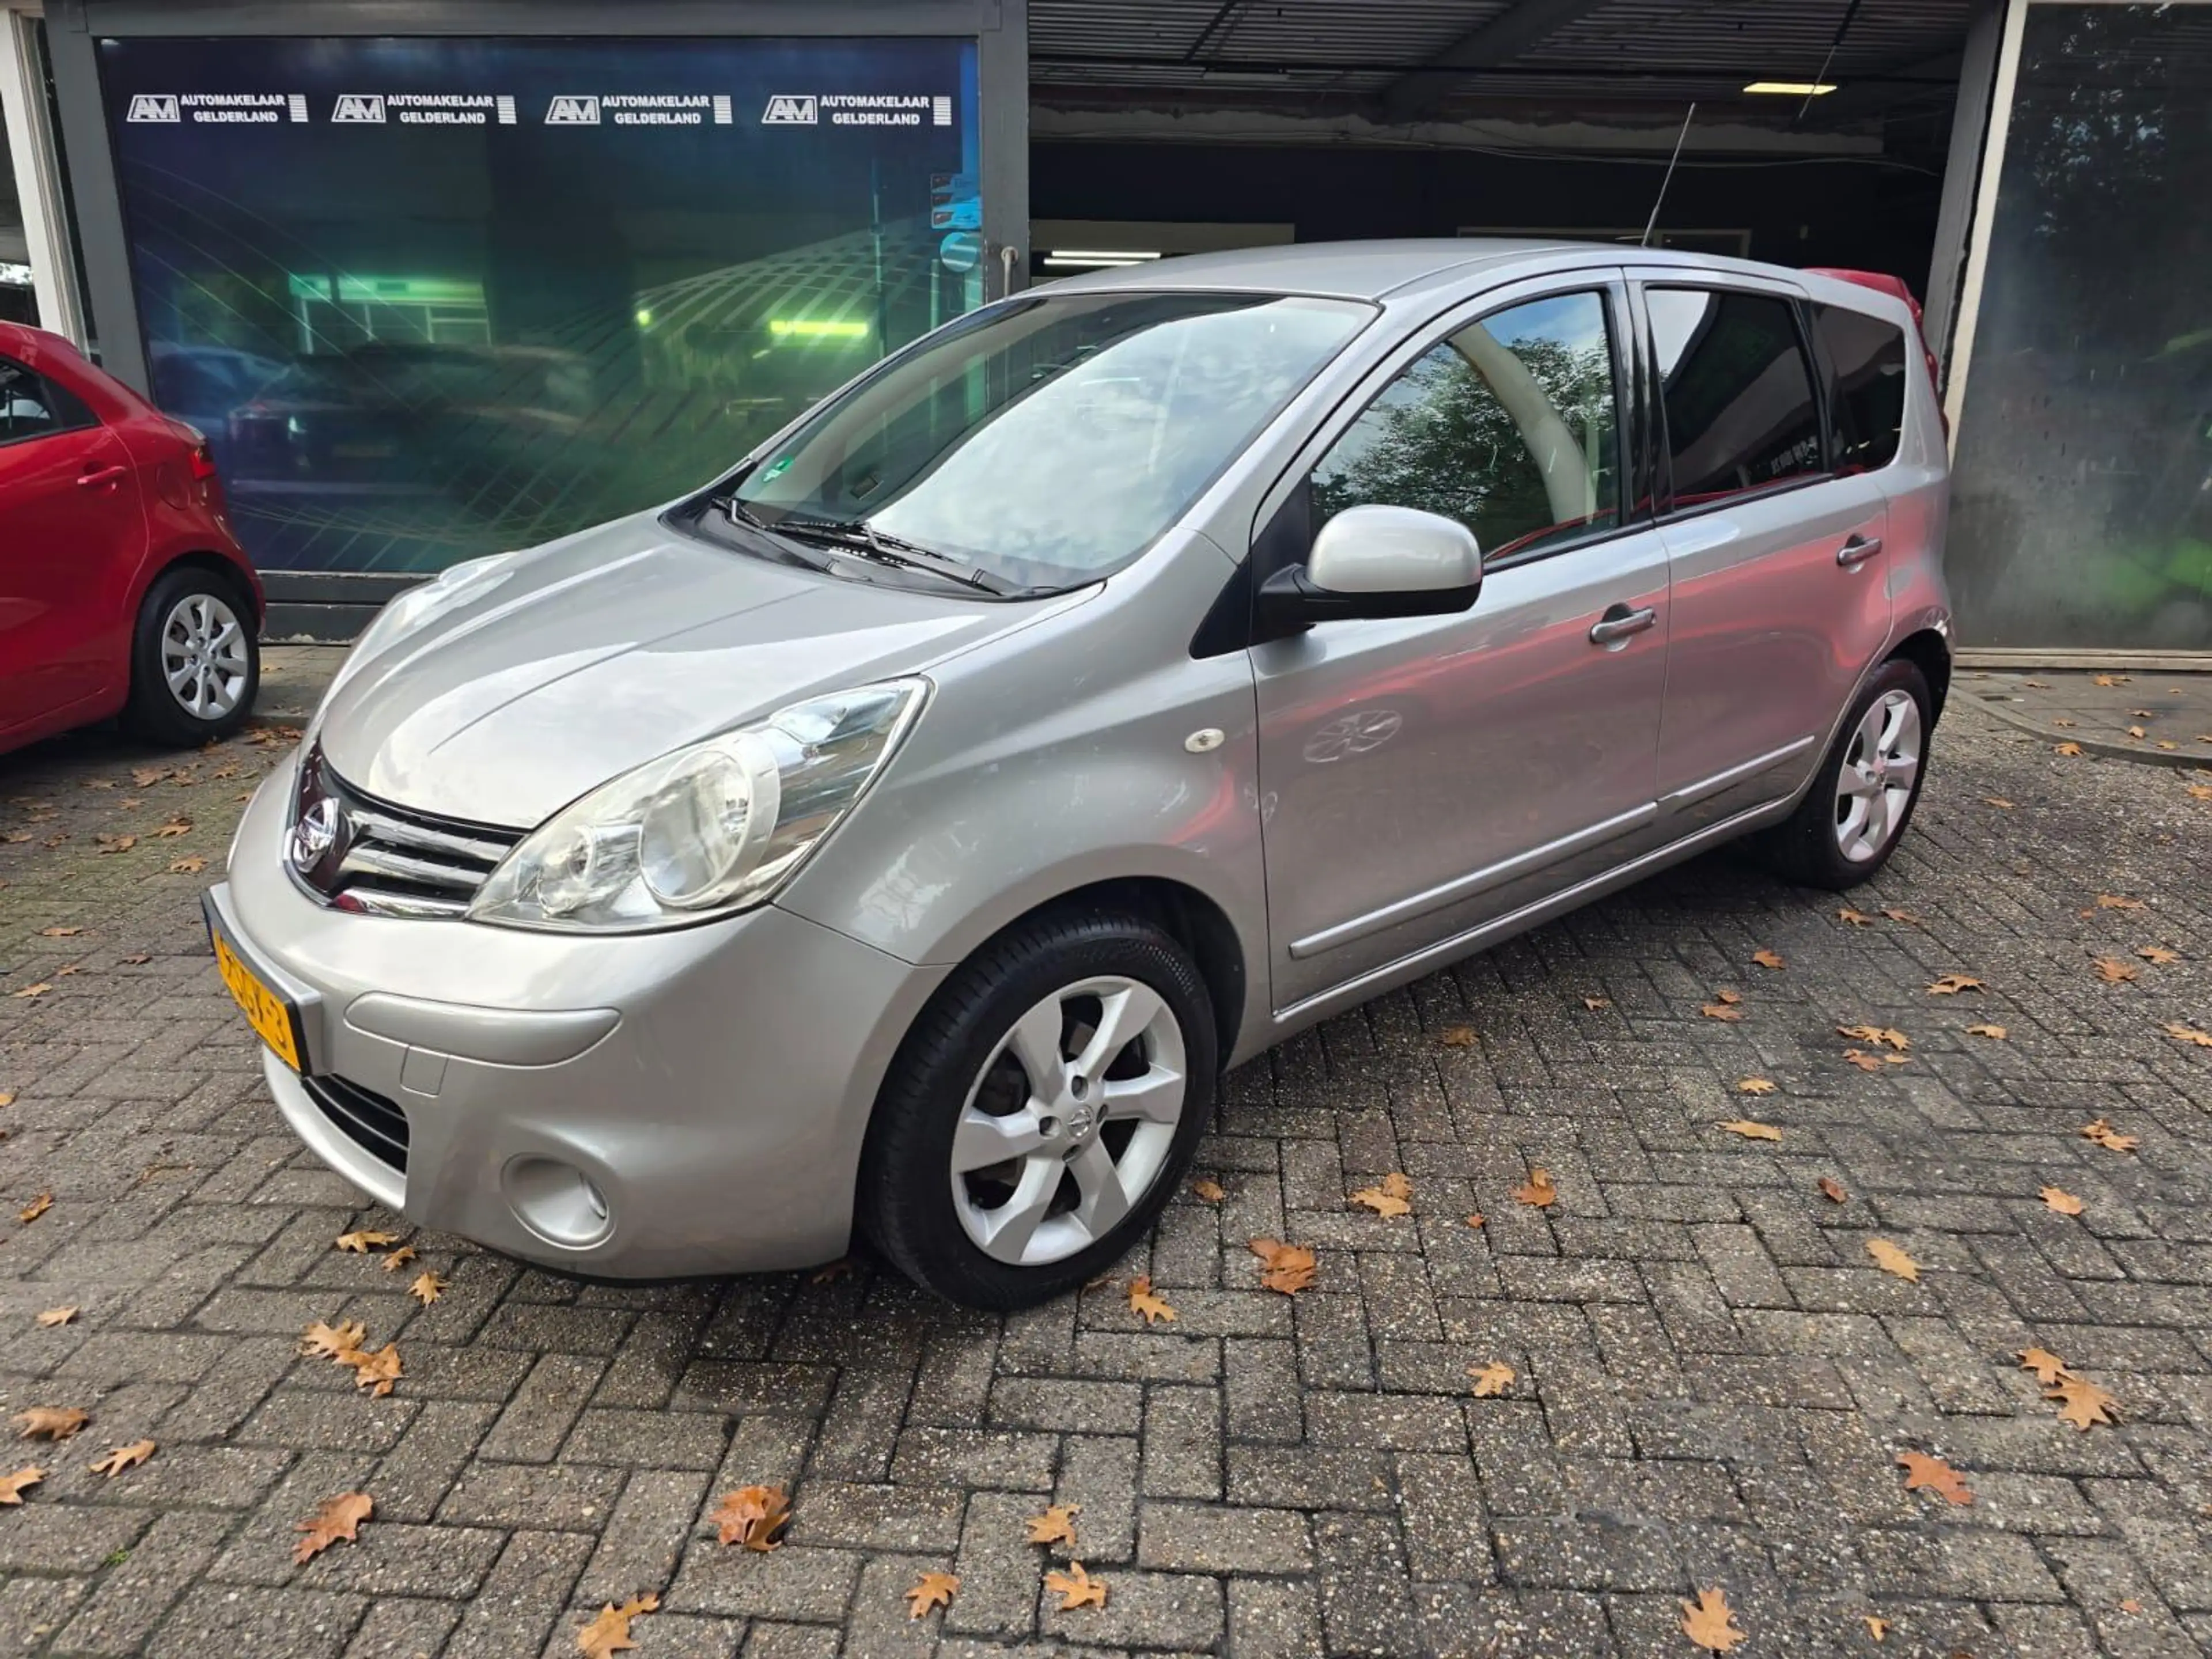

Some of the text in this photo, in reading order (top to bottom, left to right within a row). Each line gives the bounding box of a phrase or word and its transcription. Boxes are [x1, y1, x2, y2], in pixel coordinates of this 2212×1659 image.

[180, 94, 285, 106] AUTOMAKELAAR
[387, 94, 494, 107] AUTOMAKELAAR
[601, 96, 710, 108] AUTOMAKELAAR
[820, 95, 930, 108] AUTOMAKELAAR
[131, 97, 177, 120] AM
[336, 97, 384, 120] AM
[550, 98, 598, 122] AM
[767, 98, 815, 121] AM
[193, 111, 279, 123] GELDERLAND
[399, 111, 486, 124] GELDERLAND
[613, 112, 702, 124] GELDERLAND
[832, 112, 921, 125] GELDERLAND
